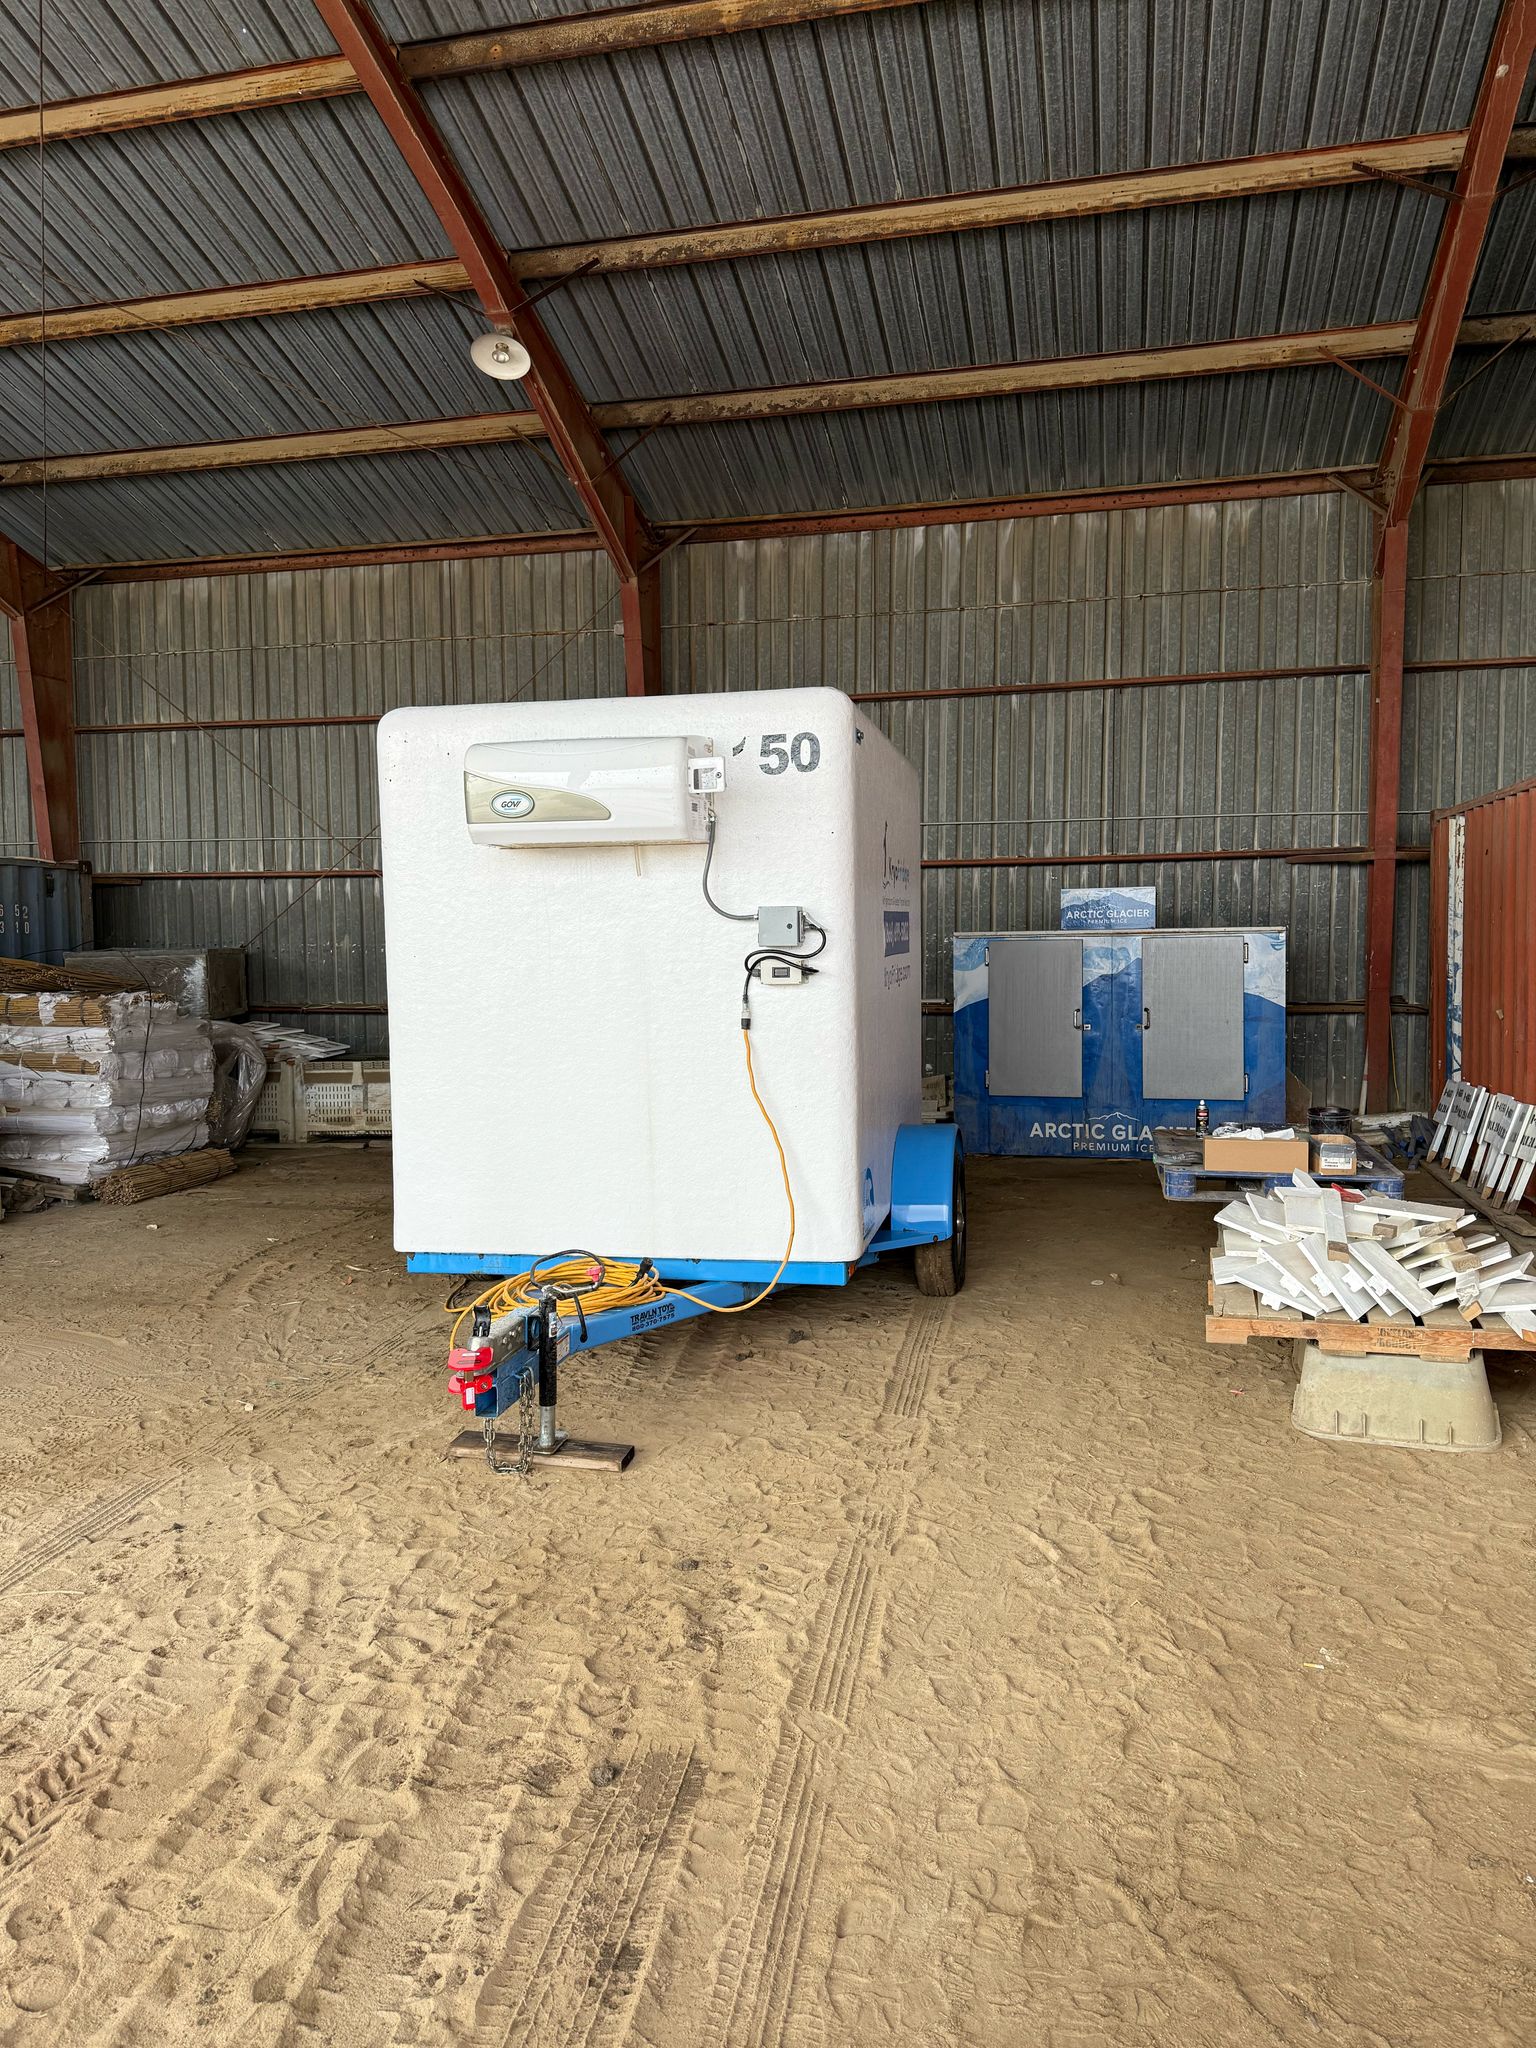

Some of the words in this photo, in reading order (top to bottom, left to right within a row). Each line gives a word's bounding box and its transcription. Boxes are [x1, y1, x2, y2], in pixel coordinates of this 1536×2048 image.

[759, 732, 820, 775] 50
[1066, 910, 1104, 919] ARCTIC
[1106, 908, 1150, 918] GLACIER
[1029, 1122, 1105, 1140] ARCTIC
[1073, 1142, 1130, 1152] PREMIUM
